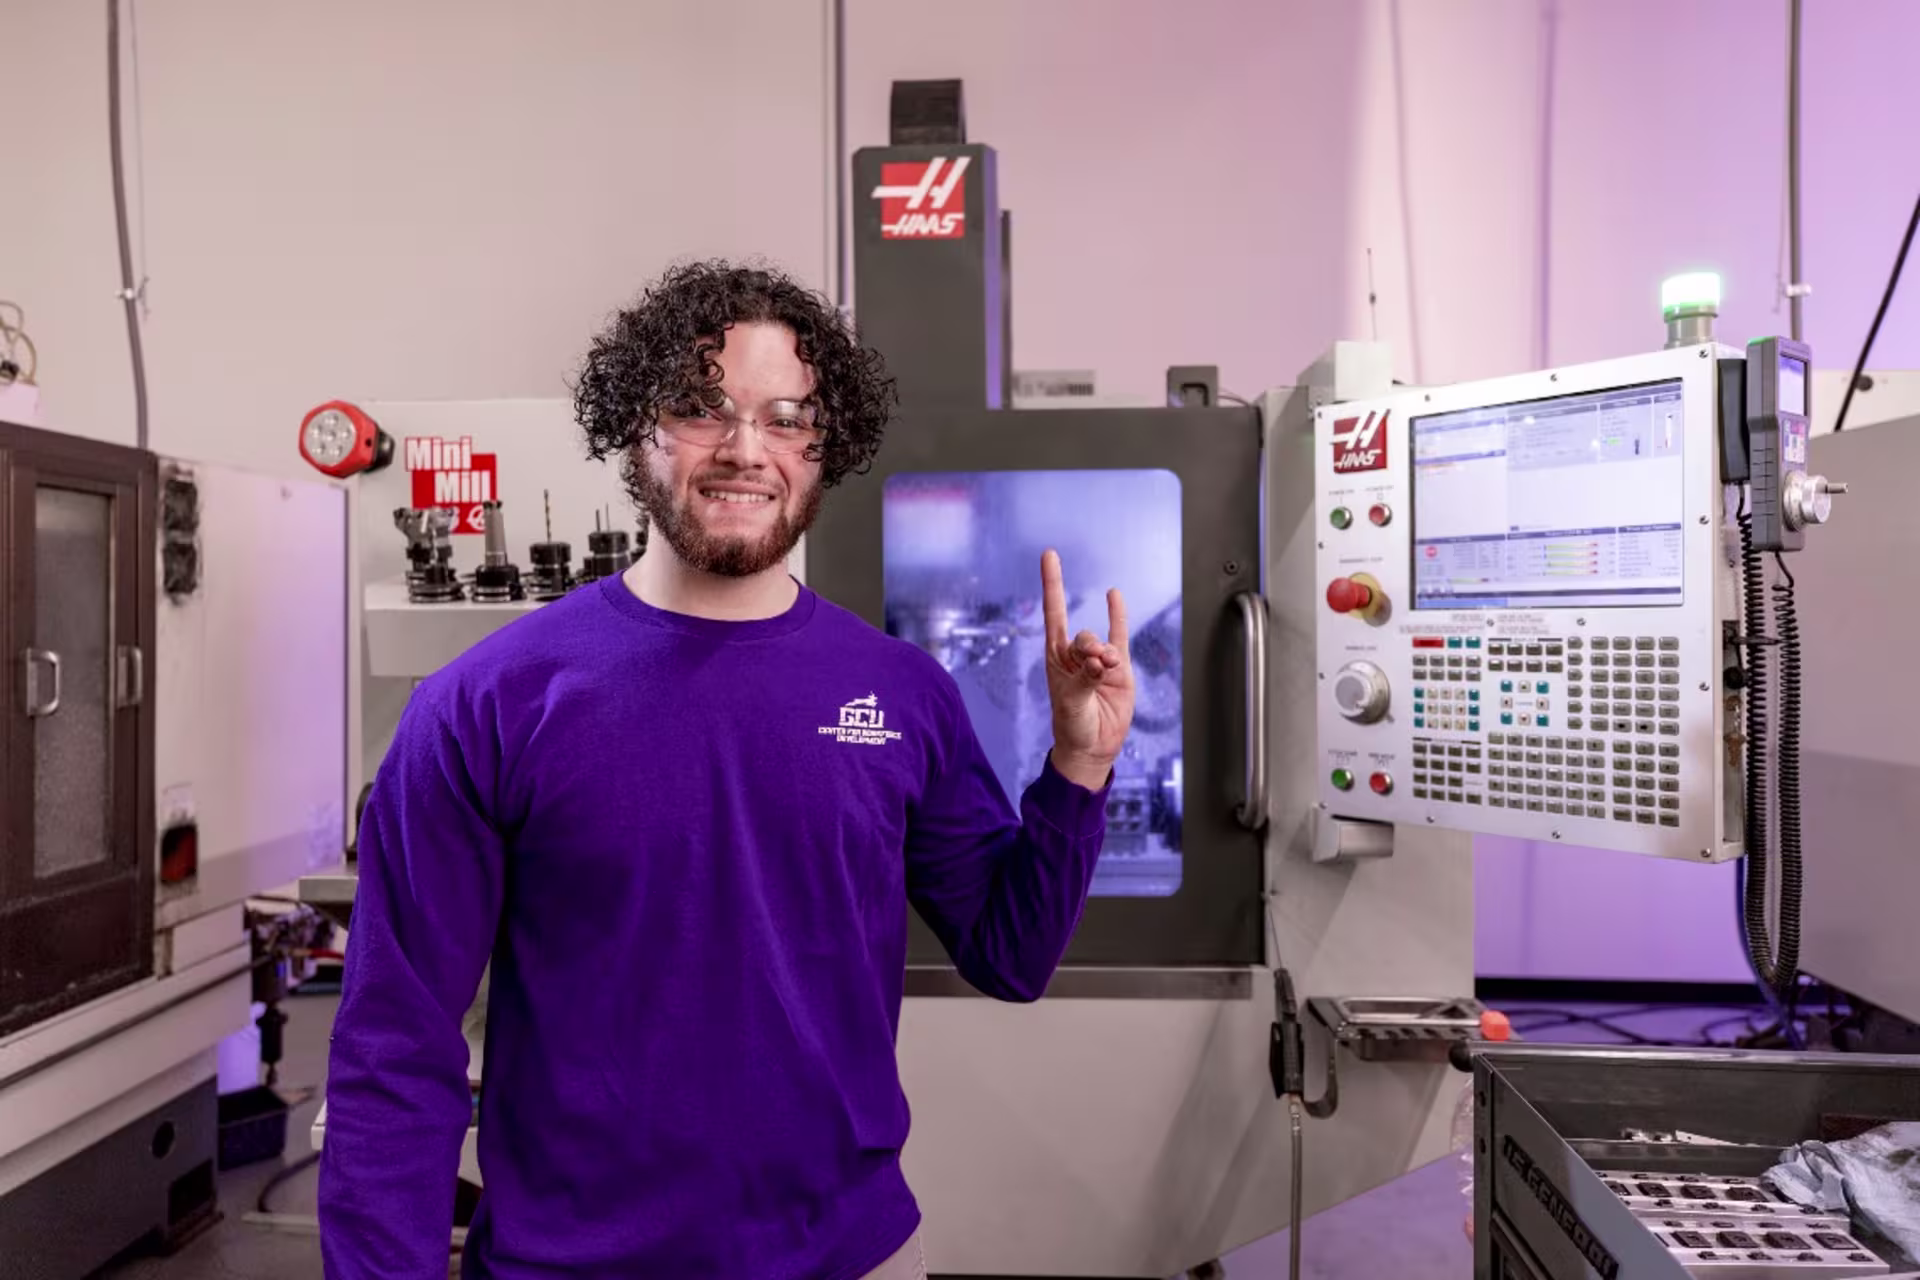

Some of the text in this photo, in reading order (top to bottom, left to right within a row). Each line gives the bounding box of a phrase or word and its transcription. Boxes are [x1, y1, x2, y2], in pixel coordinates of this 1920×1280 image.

[881, 212, 965, 236] HAAS
[405, 436, 472, 471] Mini
[1333, 448, 1382, 470] HAAS
[435, 470, 491, 503] Mill
[839, 706, 885, 728] GCU
